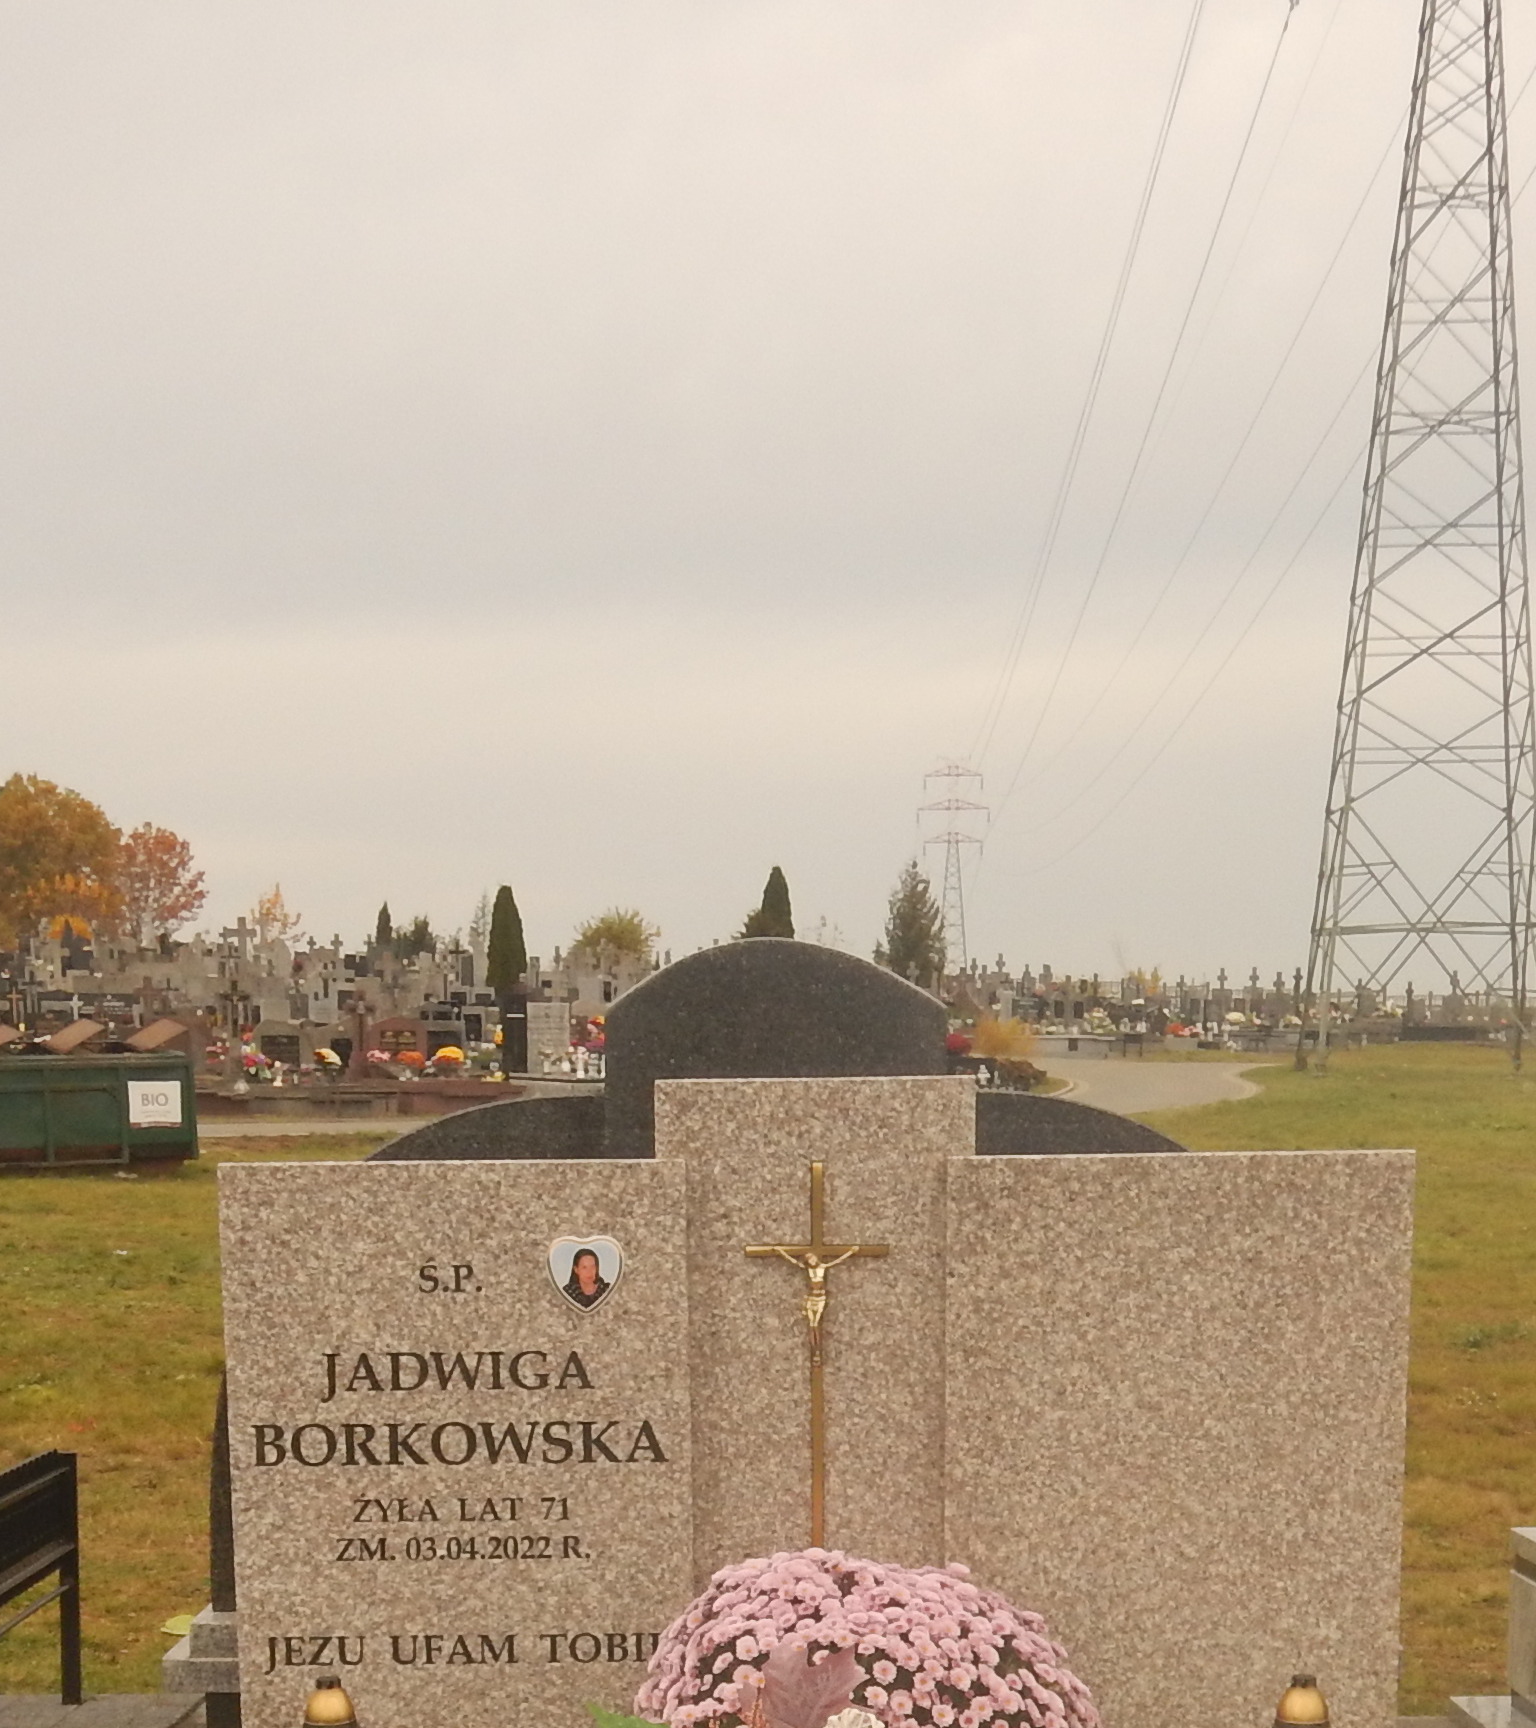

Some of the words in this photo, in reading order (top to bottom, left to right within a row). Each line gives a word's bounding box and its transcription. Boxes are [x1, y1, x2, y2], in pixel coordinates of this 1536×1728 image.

[141, 1093, 168, 1106] BIO
[417, 1258, 483, 1295] Ś.P.
[320, 1350, 596, 1404] JADWIGA
[251, 1421, 669, 1469] BORKOWSKA
[352, 1491, 439, 1524] ŻYŁA
[458, 1497, 522, 1523] LAT
[540, 1496, 570, 1522] 71
[335, 1537, 396, 1562] ZM.
[405, 1534, 550, 1561] 03.04.2022
[562, 1535, 592, 1560] R.
[263, 1634, 365, 1676] JEZU
[390, 1633, 517, 1666] UFAM
